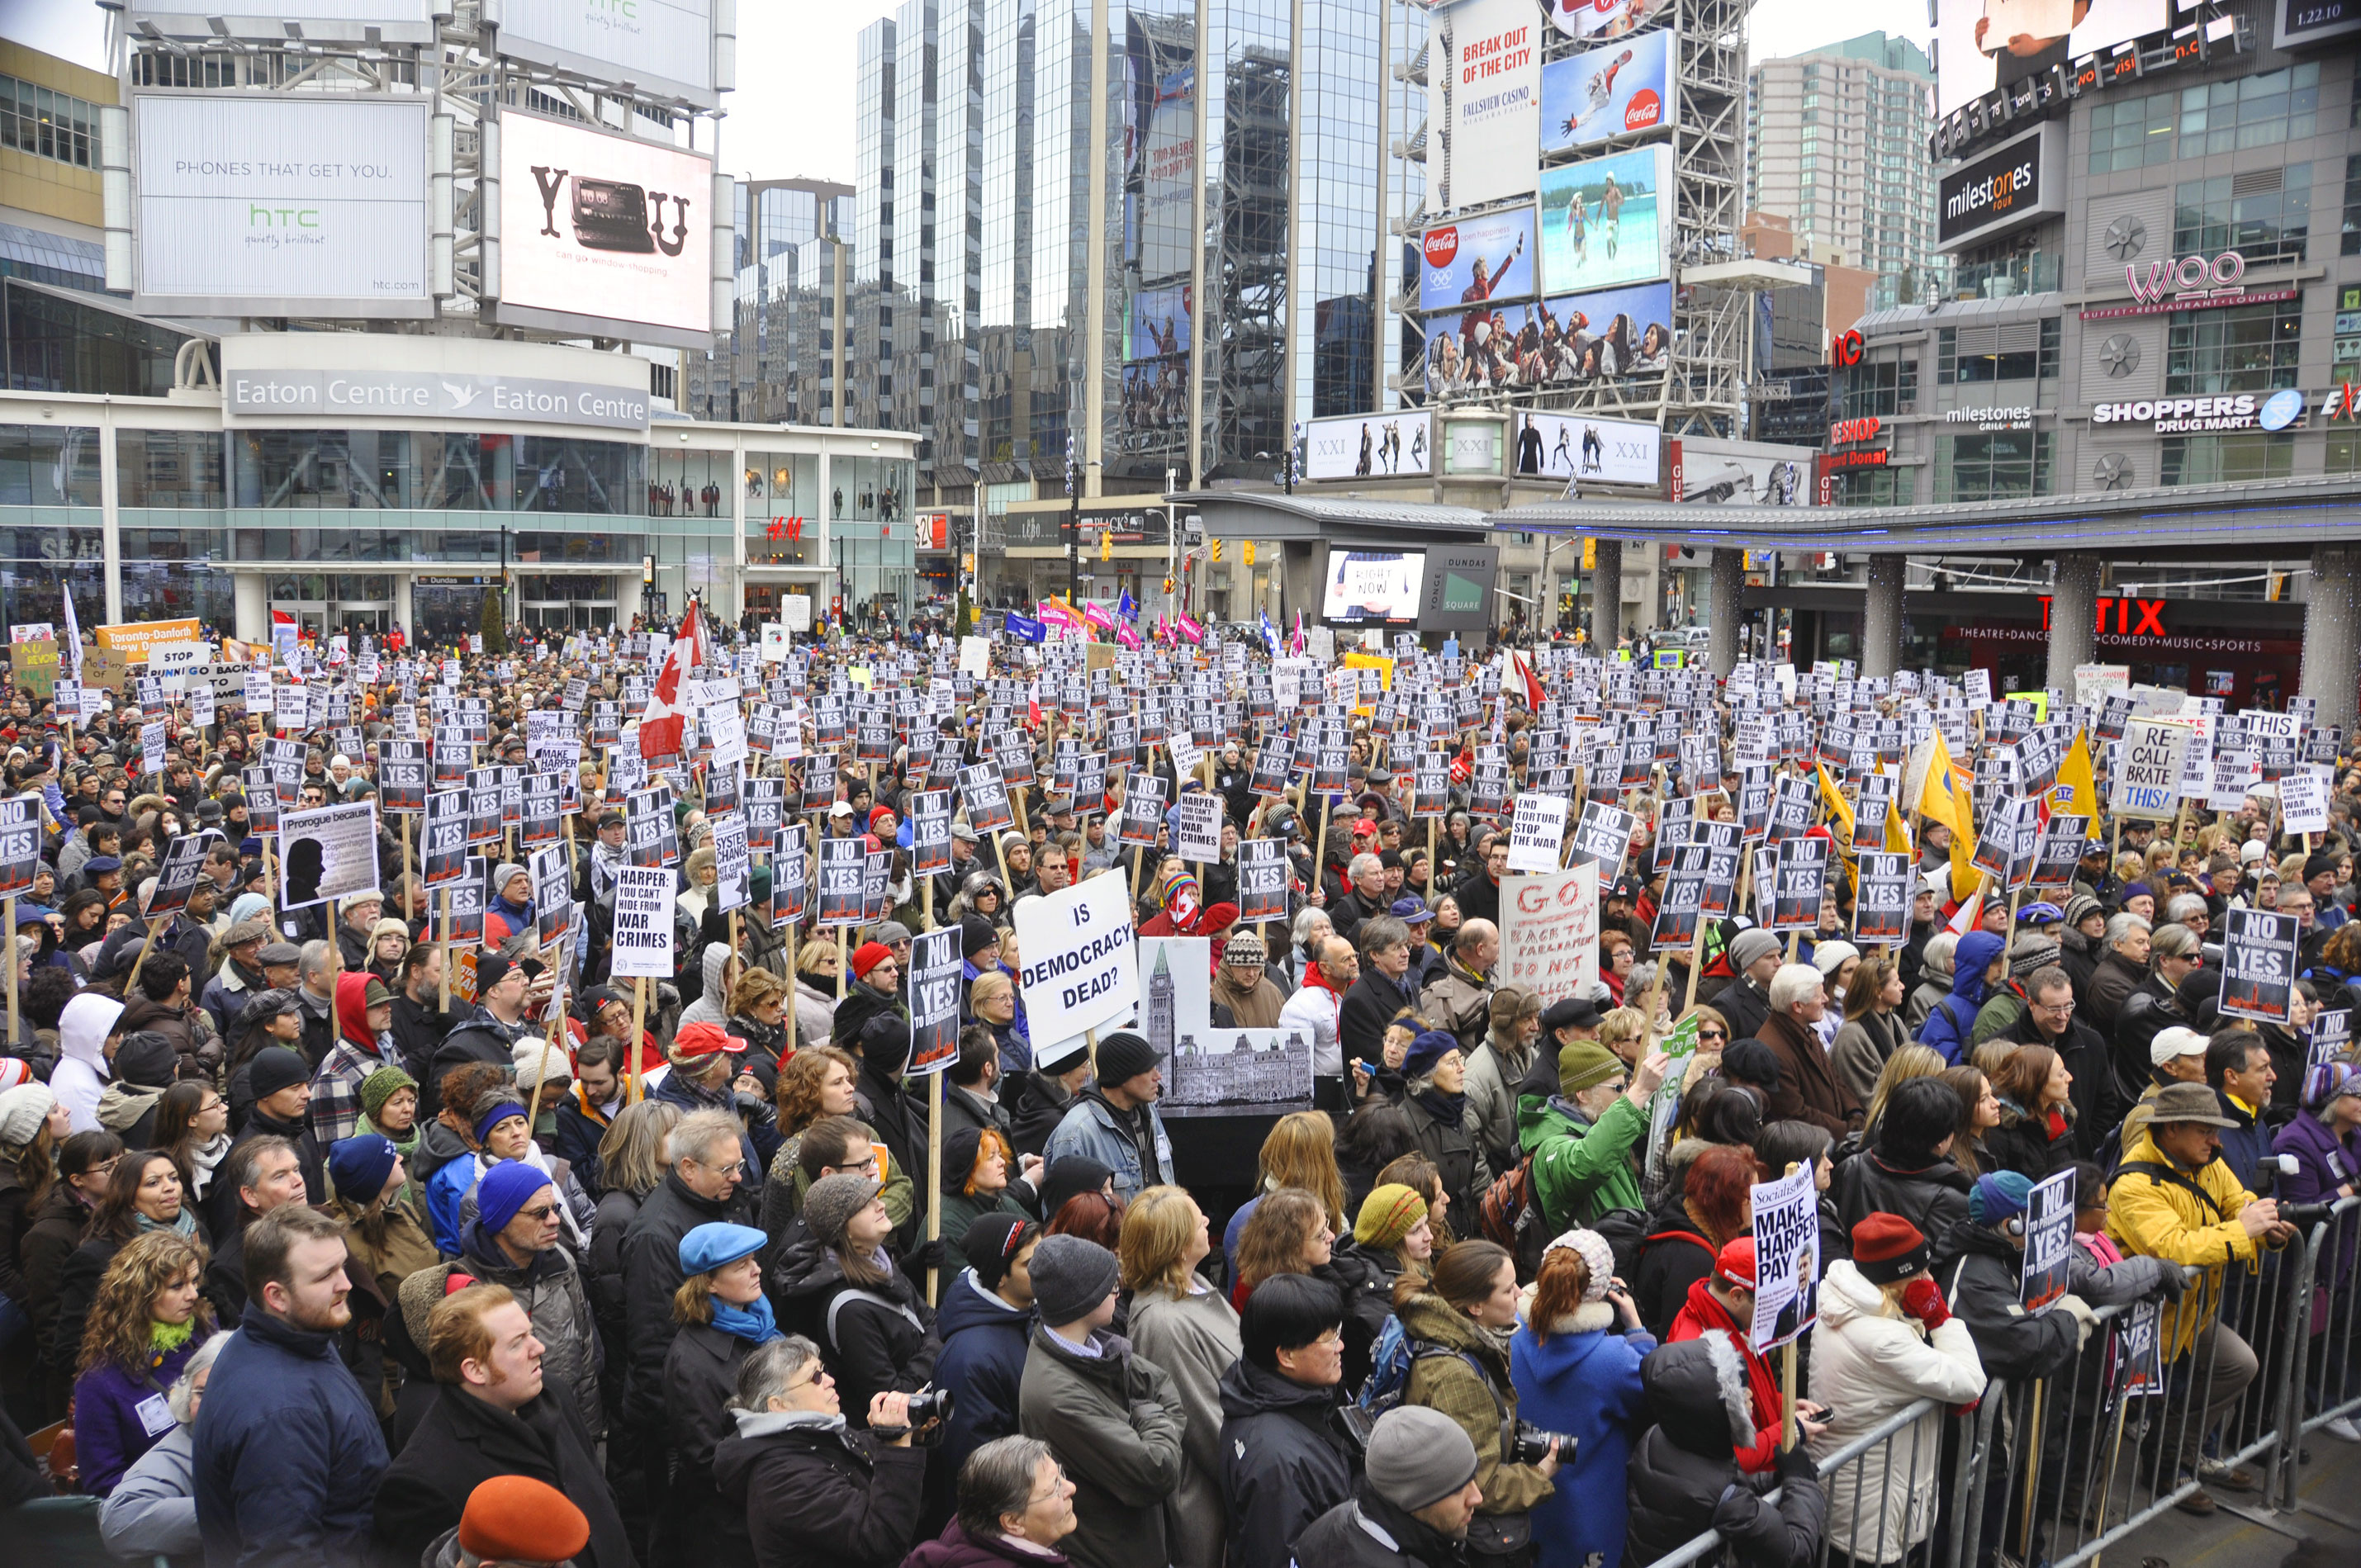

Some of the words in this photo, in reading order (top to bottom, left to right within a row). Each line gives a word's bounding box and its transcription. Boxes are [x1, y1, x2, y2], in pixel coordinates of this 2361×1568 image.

[2298, 5, 2340, 26] 1.22.10
[1463, 36, 1501, 62] BREAK
[1505, 26, 1528, 50] OUT
[1463, 64, 1477, 83] OF
[1480, 57, 1501, 79] THE
[1505, 48, 1530, 72] CITY
[1463, 95, 1501, 117] FALLSVIEW
[1502, 86, 1529, 106] CASINO
[1463, 111, 1501, 126] NIAGARA
[1505, 103, 1529, 116] FALLS
[176, 161, 251, 175] PHONES
[258, 163, 302, 177] THAT
[309, 164, 343, 178] GET
[351, 165, 392, 178] YOU.
[1948, 163, 2031, 220] milestones
[1993, 196, 2012, 211] FOUR
[245, 234, 279, 249] quietly
[286, 234, 325, 245] brilliant
[1460, 232, 1475, 244] open
[1477, 225, 1510, 240] happiness
[556, 251, 572, 259] can
[576, 254, 588, 263] go
[373, 280, 419, 290] htc.com
[2084, 310, 2126, 319] BUFFET
[2137, 299, 2217, 314] RESTAURANT
[2229, 291, 2288, 305] LOUNGE
[236, 380, 316, 403] Eaton
[329, 380, 429, 405] Centre
[495, 386, 568, 413] Eaton
[578, 393, 643, 419] Centre
[2093, 395, 2254, 423] SHOPPERS
[1946, 405, 2031, 423] milestones
[1842, 418, 1880, 443] SHOP
[1979, 422, 2003, 431] GRILL
[2013, 421, 2031, 429] BAR
[2155, 419, 2202, 433] DRUG
[2206, 415, 2254, 430] MART
[1318, 439, 1345, 456] XXI
[1458, 440, 1488, 452] XXI
[1616, 443, 1647, 459] XXI
[766, 516, 802, 542] H&M
[1448, 559, 1486, 567] DUNDAS
[1356, 568, 1392, 580] RIGHT
[1358, 580, 1387, 594] NOW
[1431, 574, 1441, 610] YONGE
[1446, 601, 1479, 609] SQUARE
[109, 627, 192, 643] Toronto-Danforth
[1960, 628, 2004, 640] THEATRE
[2011, 630, 2051, 641] DANCE
[2102, 634, 2155, 647] COMEDY
[2162, 637, 2203, 649] MUSIC
[2212, 640, 2261, 651] SPORTS
[111, 642, 137, 651] New
[164, 652, 193, 661] STOP
[216, 665, 250, 674] BACK
[209, 678, 228, 686] TO
[701, 685, 725, 699] We
[713, 703, 733, 721] Stand
[718, 727, 732, 738] On
[2245, 714, 2292, 736] THIS
[2146, 727, 2178, 746] RE-
[543, 750, 568, 759] MAKE
[714, 745, 742, 763] Guard
[2132, 747, 2175, 765] CALI-
[541, 760, 577, 768] HARPER
[2126, 766, 2171, 784] BRATE
[1518, 799, 1537, 811] END
[2126, 787, 2170, 809] THIS!
[287, 816, 330, 830] Prorogue
[333, 809, 371, 822] because
[1516, 810, 1562, 825] TORTURE.
[1515, 822, 1540, 834] STOP
[325, 837, 371, 851] Copenhagen
[1513, 835, 1530, 846] THE
[1533, 837, 1558, 850] WAR.
[717, 843, 747, 864] CHANGE
[1873, 856, 1898, 875] NO
[620, 869, 669, 888] HARPER:
[1861, 874, 1870, 883] TO
[619, 886, 634, 898] YOU
[638, 888, 660, 900] CAN'T
[1866, 885, 1903, 904] YES
[619, 899, 637, 910] HIDE
[640, 901, 661, 912] FROM
[1074, 903, 1090, 926] IS
[1859, 903, 1867, 912] TO
[1869, 903, 1904, 912] DEMOCRACY
[618, 913, 648, 930] WAR
[2245, 913, 2278, 939] NO
[616, 931, 667, 949] CRIMES
[1511, 927, 1558, 944] BACK
[1564, 923, 1586, 936] TO
[2229, 933, 2239, 945] TO
[2240, 935, 2292, 951] PROROGUING
[927, 932, 950, 966] NO
[1519, 934, 1595, 957] PARLIAMENT
[1022, 922, 1131, 989] DEMOCRACY
[2235, 946, 2283, 976] YES
[913, 970, 922, 983] TO
[924, 958, 961, 979] PROROGUING
[1513, 962, 1538, 977] DO
[1548, 955, 1583, 976] NOT
[2226, 967, 2237, 978] TO
[2238, 970, 2290, 987] DEMOCRACY
[919, 978, 955, 1015] YES
[1063, 967, 1118, 1009] DEAD?
[914, 1016, 924, 1029] TO
[925, 1004, 958, 1027] DEMOCRACY
[2042, 1180, 2065, 1217] NO
[1756, 1197, 1804, 1239] MAKE
[2029, 1220, 2038, 1232] TO
[2039, 1201, 2073, 1229] PROROGUING
[1757, 1212, 1816, 1262] HARPER
[2034, 1222, 2067, 1263] YES
[1759, 1253, 1791, 1287] PAY
[2026, 1264, 2035, 1277] TO
[2036, 1248, 2070, 1273] DEMOCRACY
